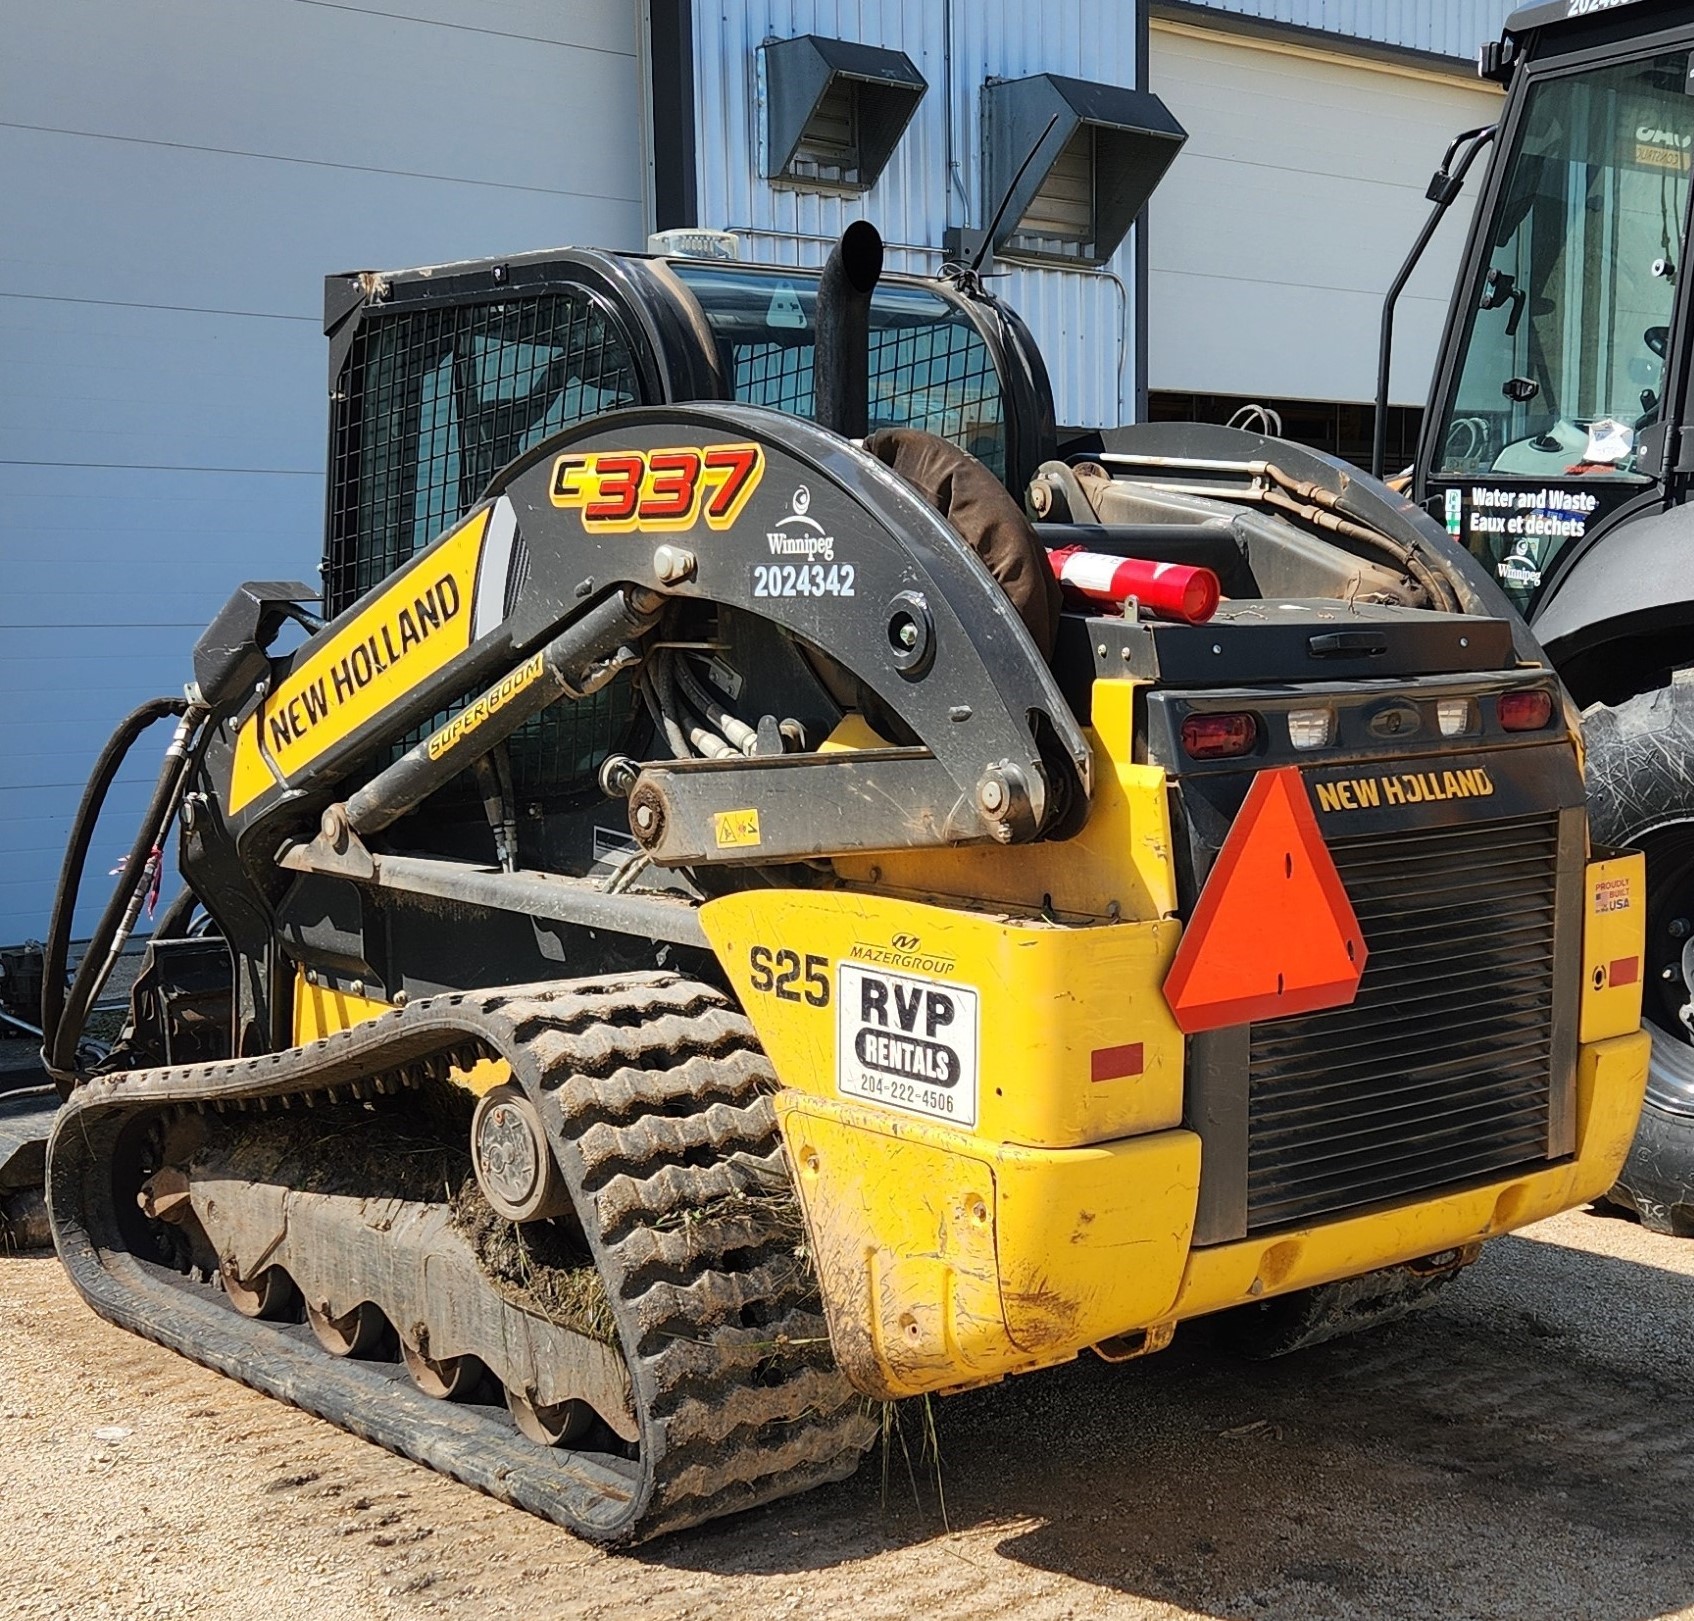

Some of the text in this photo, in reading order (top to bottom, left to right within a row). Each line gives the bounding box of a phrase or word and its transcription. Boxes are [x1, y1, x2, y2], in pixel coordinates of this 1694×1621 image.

[1472, 487, 1595, 511] Water and Waste
[1470, 512, 1585, 537] Eaux et déchets
[766, 533, 834, 561] Winnipeg
[754, 564, 856, 597] 2024342
[1497, 563, 1541, 586] Winnipeg
[269, 573, 461, 753] NEW HOLLAND
[431, 656, 541, 754] SUPER BOOM
[1315, 768, 1494, 812] NEW HOLLAND
[1595, 879, 1629, 890] PROUDLY
[1609, 888, 1629, 898] BUILT
[1609, 898, 1630, 911] USA
[850, 946, 955, 975] MAZERGROUP
[750, 945, 830, 1008] S25
[861, 976, 955, 1038] RVP
[865, 1034, 949, 1082] RENTALS
[861, 1073, 954, 1113] 204-222-4506
